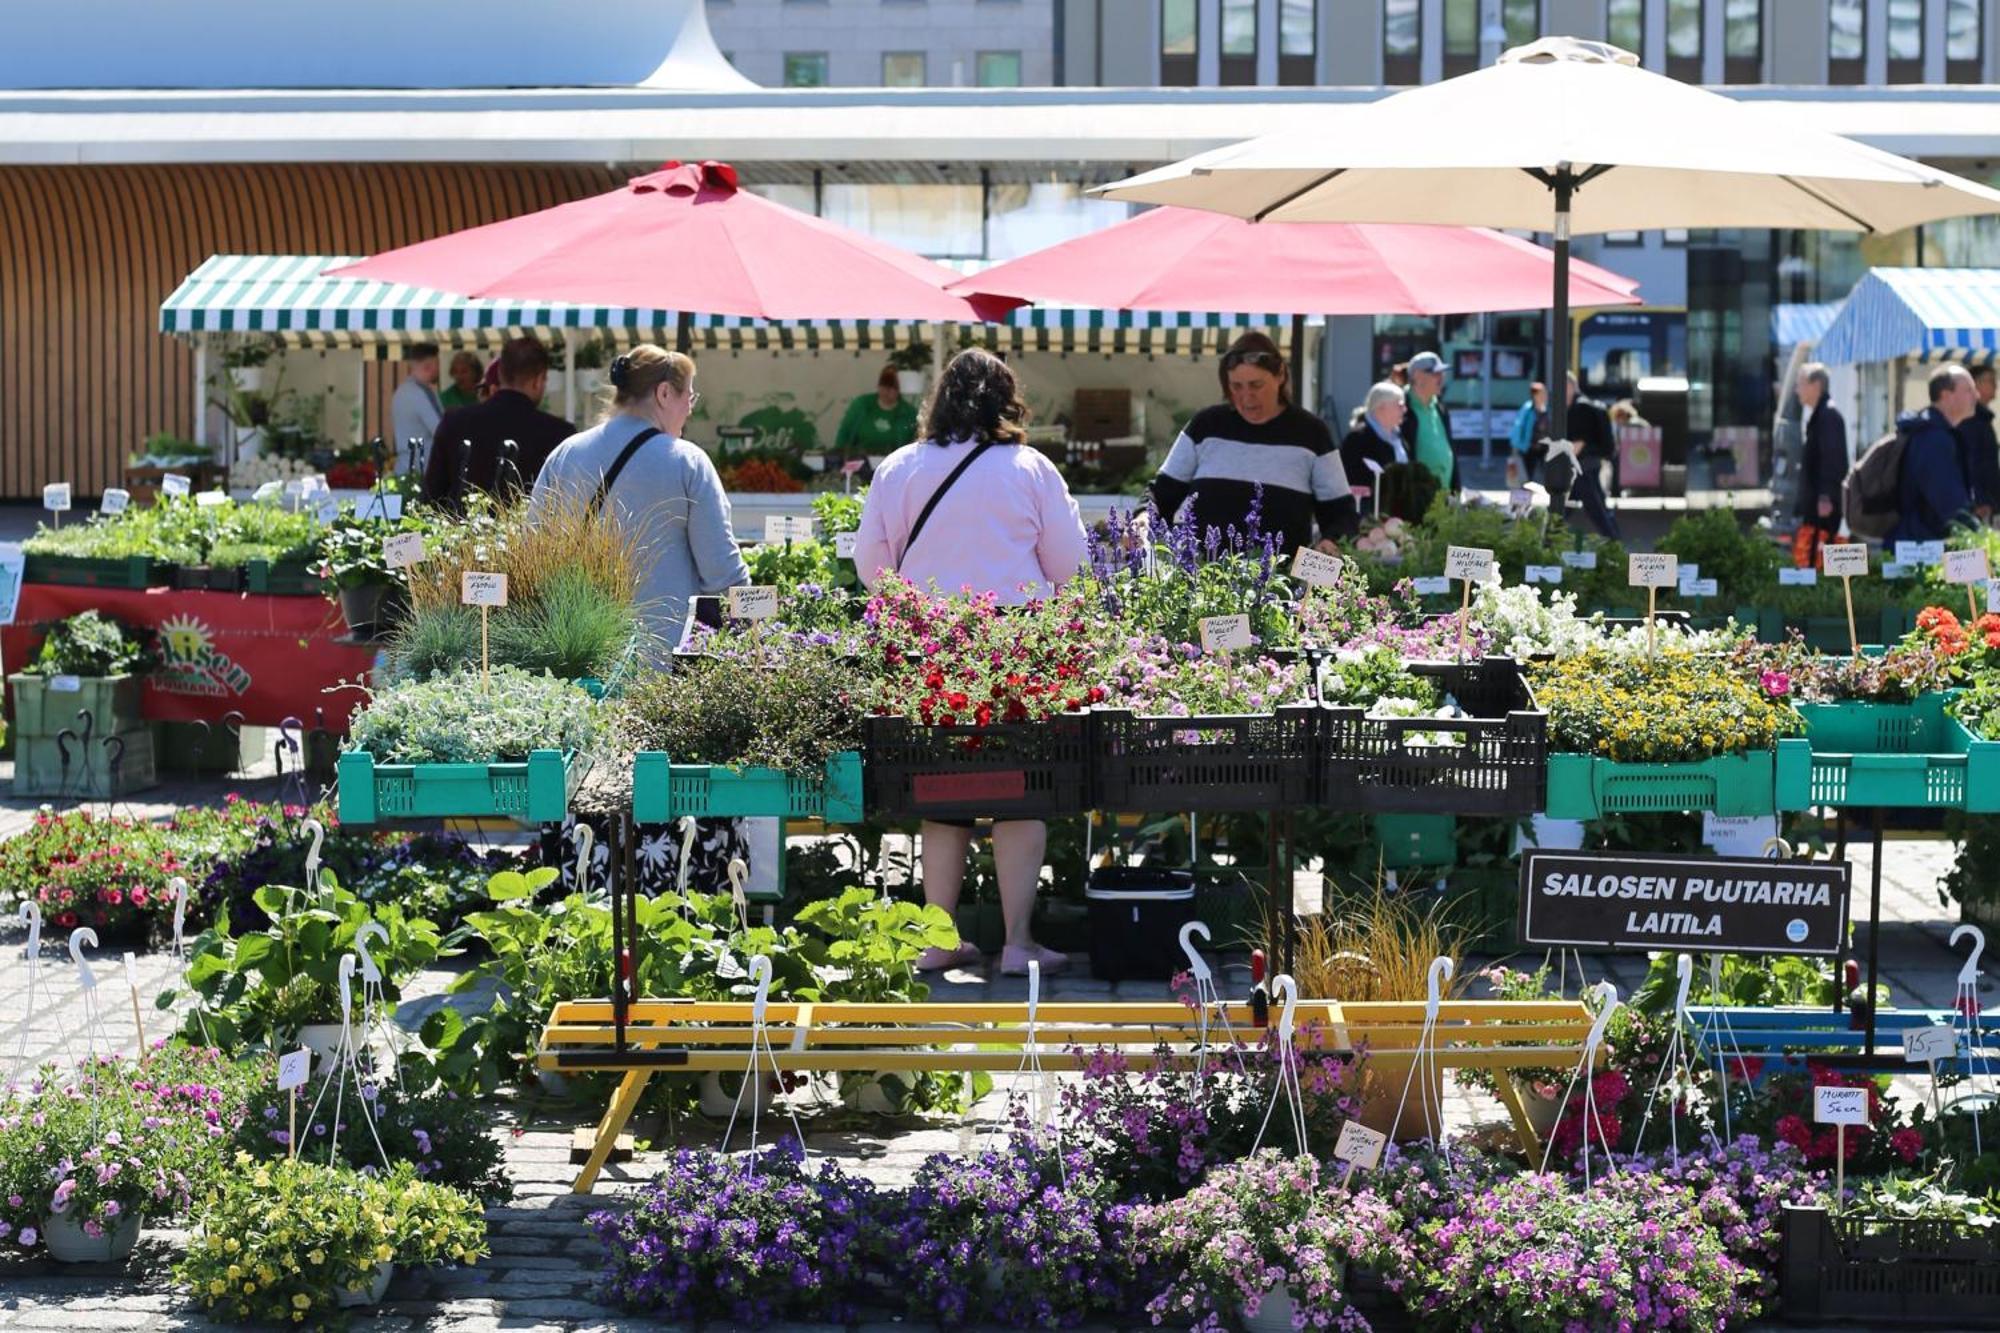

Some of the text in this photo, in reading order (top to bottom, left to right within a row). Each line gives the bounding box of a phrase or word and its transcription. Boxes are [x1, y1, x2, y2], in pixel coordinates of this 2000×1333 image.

[1542, 872, 1831, 906] SALOSEN PUUTARHA
[1626, 911, 1722, 936] LAITILA
